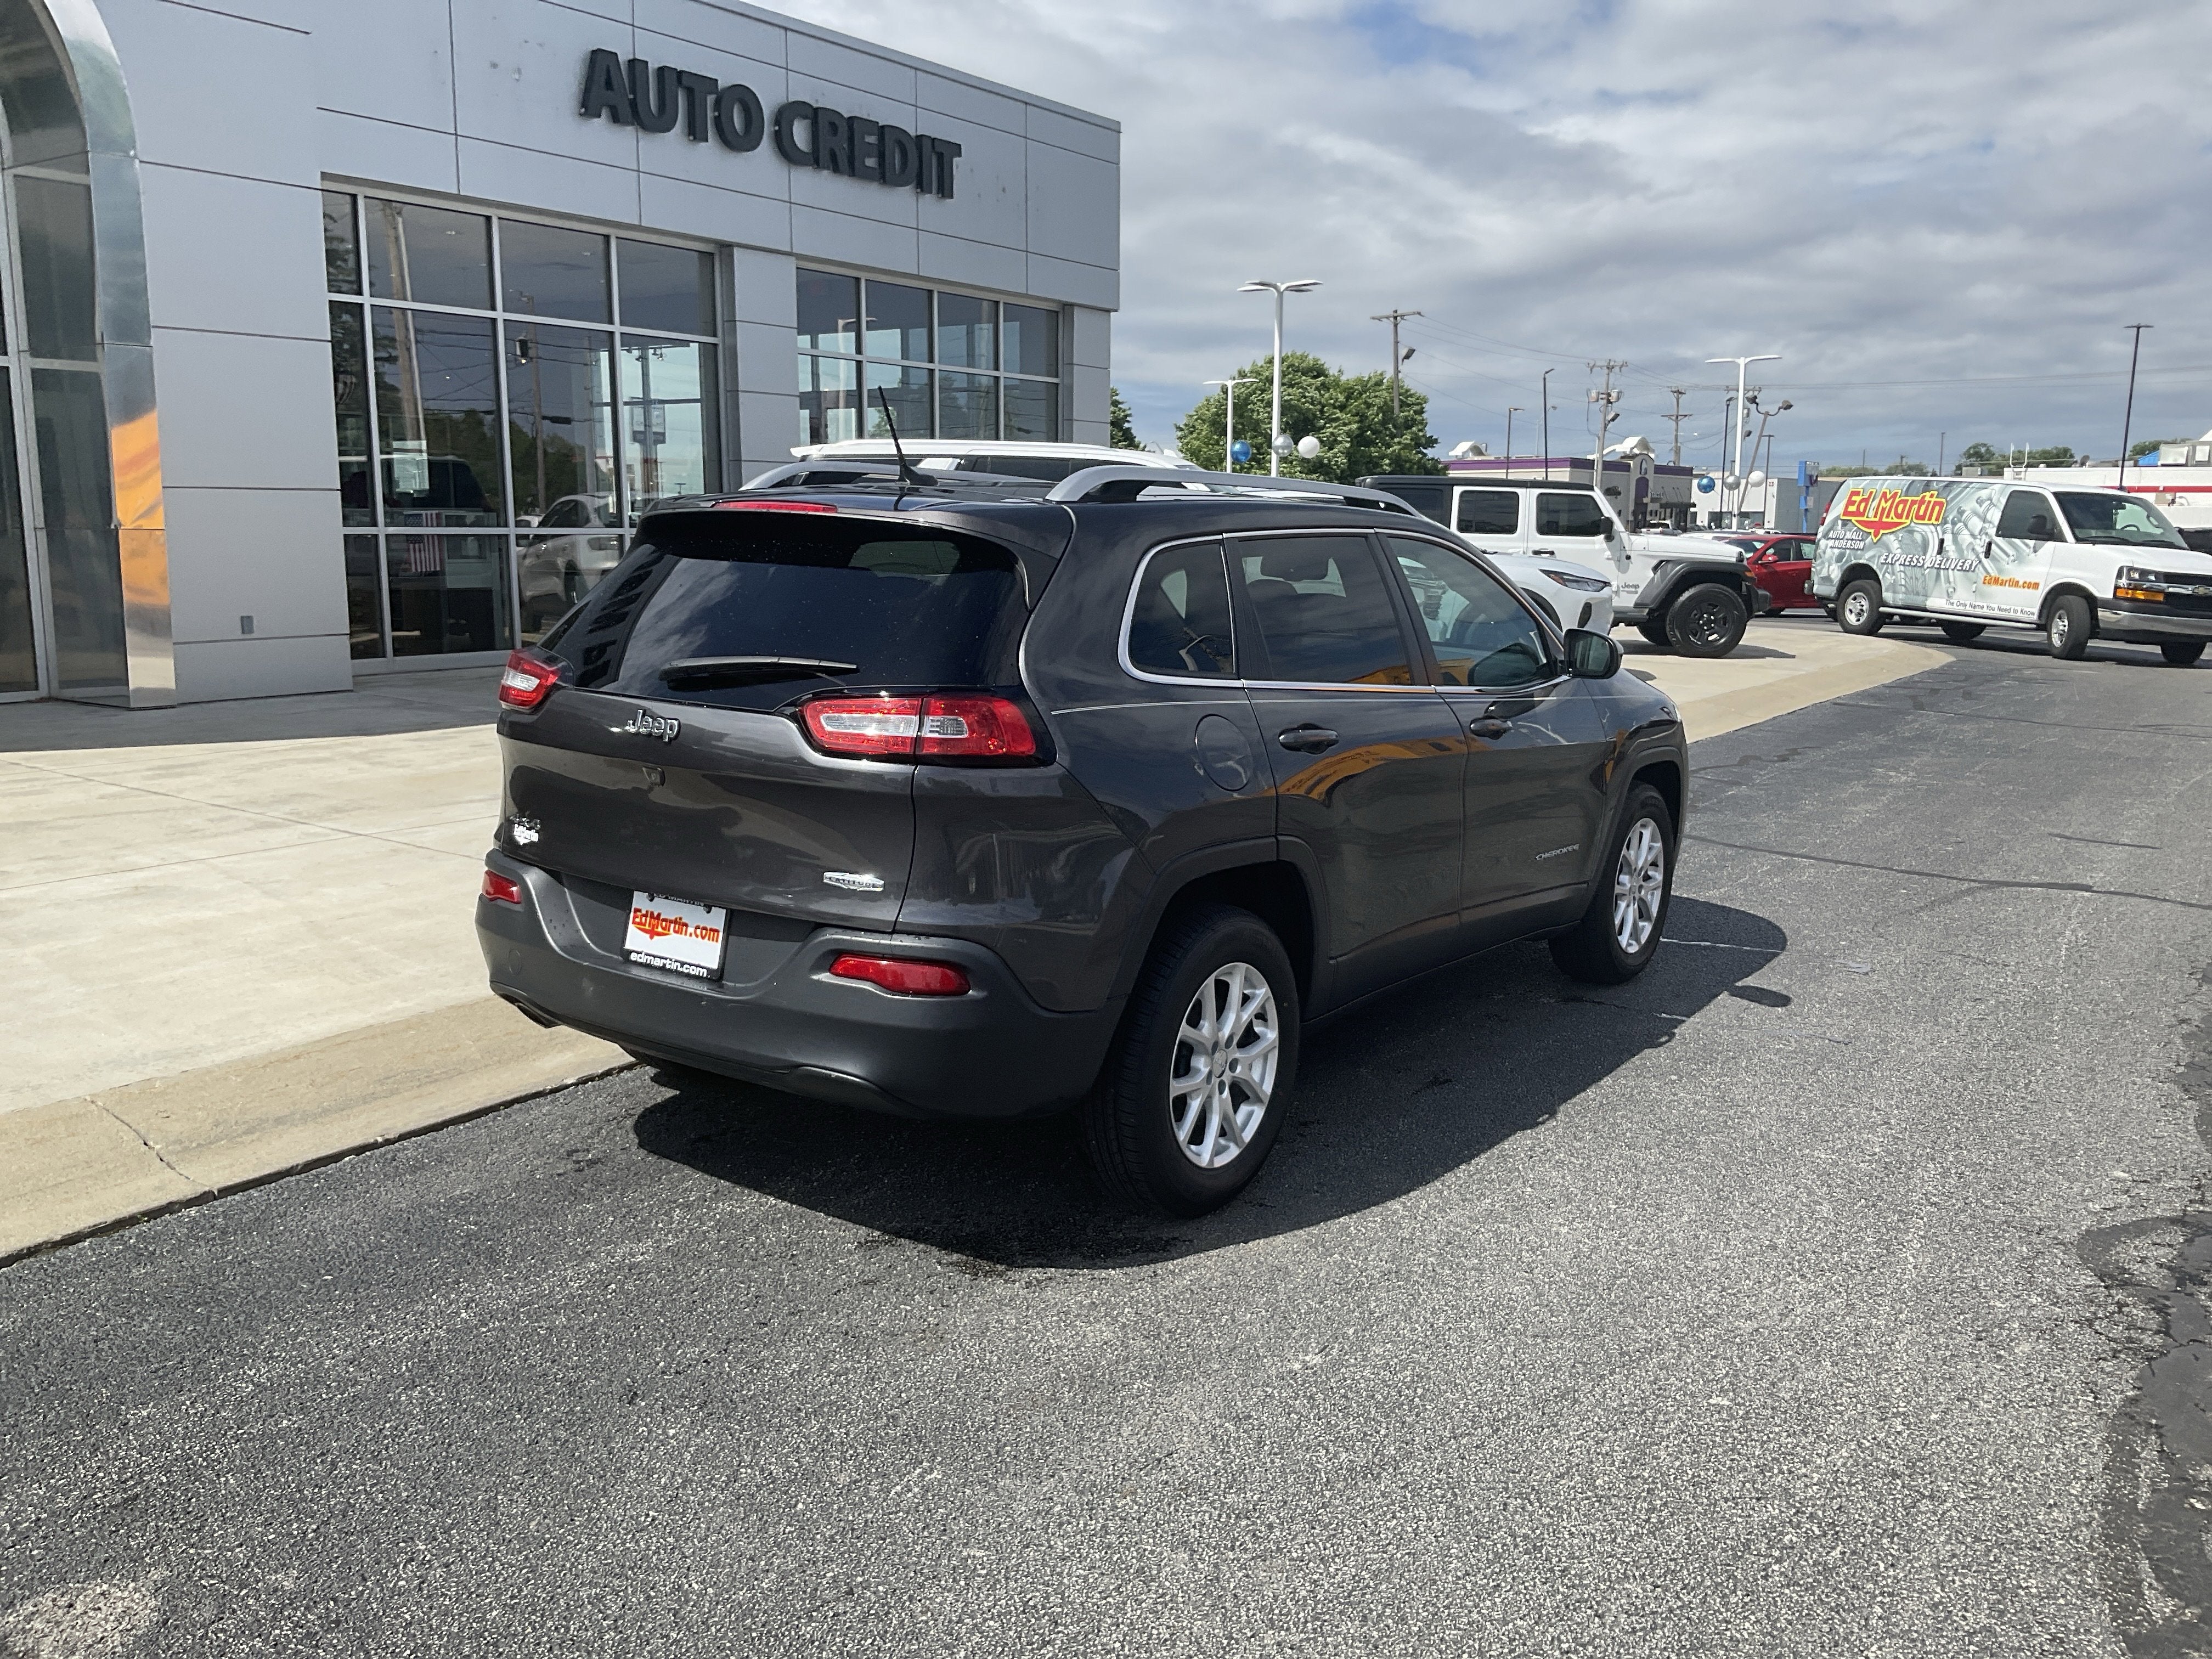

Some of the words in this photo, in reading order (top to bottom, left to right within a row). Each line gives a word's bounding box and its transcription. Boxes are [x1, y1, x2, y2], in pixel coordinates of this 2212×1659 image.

[579, 48, 764, 152] AUTO
[774, 100, 962, 199] CREDIT
[1841, 489, 1876, 520] Ed
[1873, 489, 1946, 524] Martin
[1828, 530, 1844, 539] AUTO
[1845, 531, 1863, 540] MALL
[1830, 539, 1865, 549] ANDERSON
[1881, 552, 1926, 566] EXPRESS
[1927, 556, 1979, 572] DELIVERY
[1982, 575, 2040, 590] EdMartin.com
[1956, 600, 1968, 610] Only
[1969, 602, 1984, 610] Name
[1986, 603, 1995, 612] You
[1997, 605, 2011, 614] Need
[625, 709, 679, 742] Jeep
[1536, 844, 1579, 860] CHEROKEE
[631, 907, 720, 943] EdMartin.com
[630, 951, 707, 978] edmartin.com
